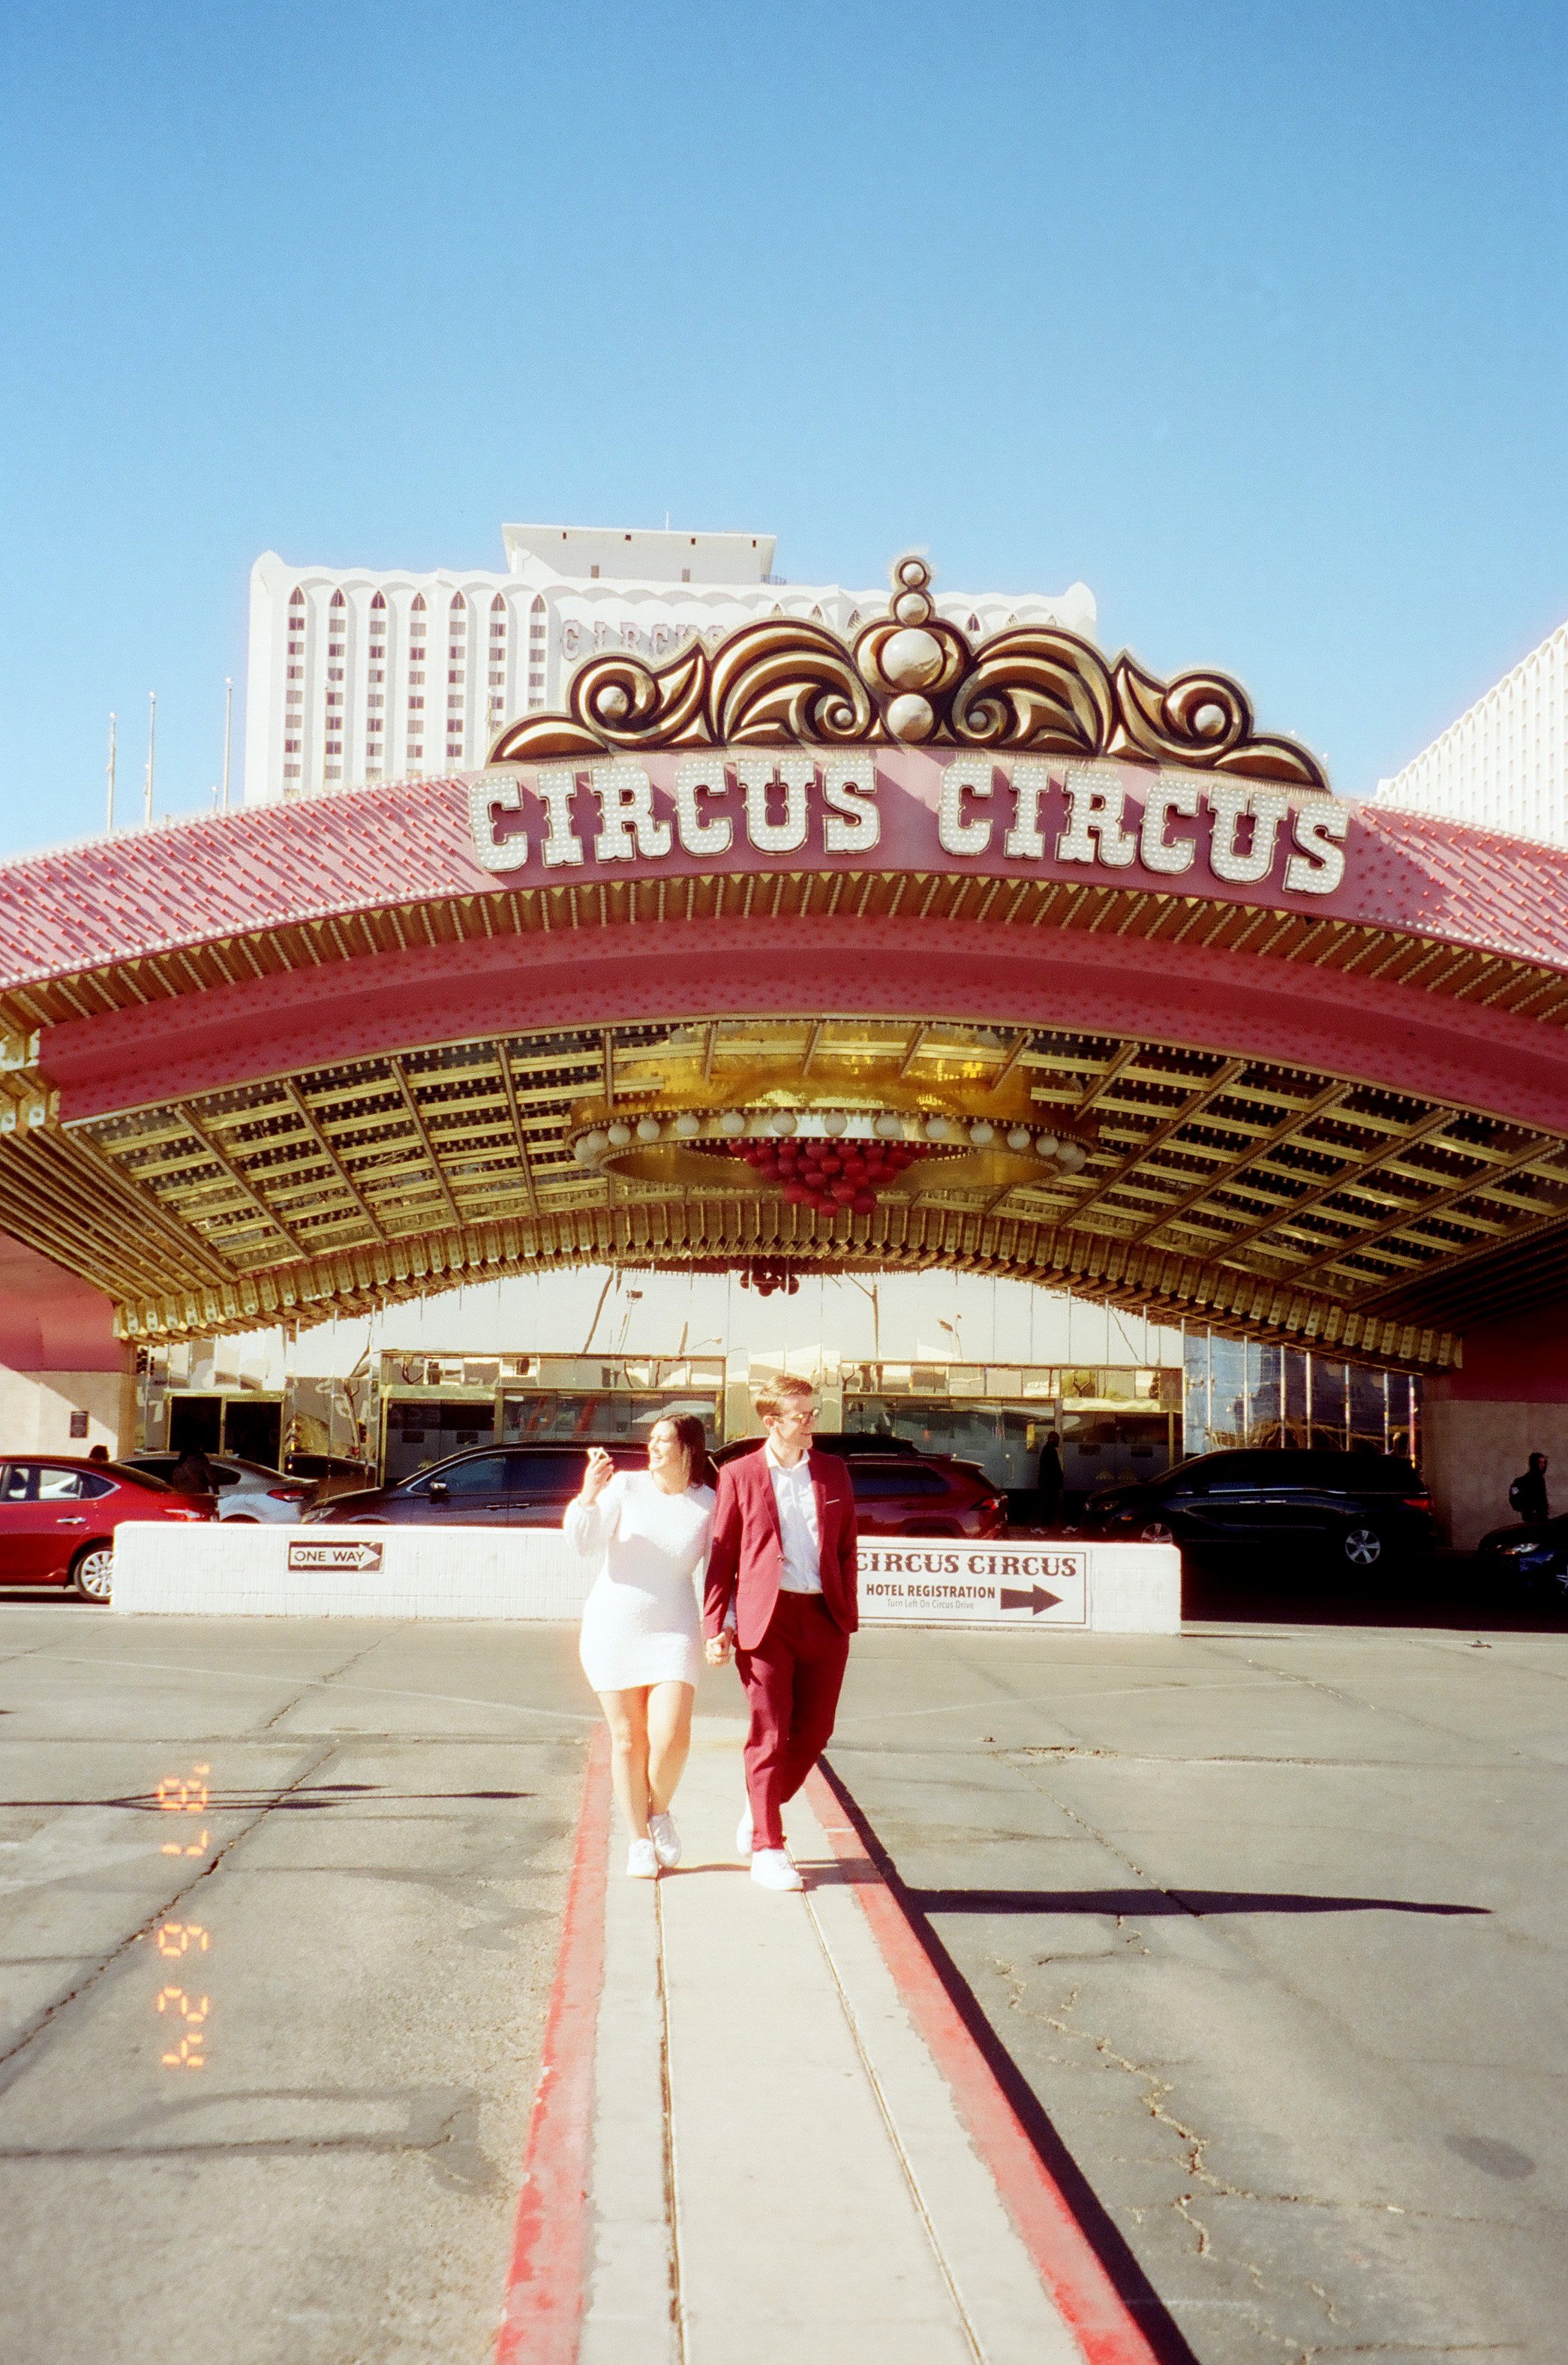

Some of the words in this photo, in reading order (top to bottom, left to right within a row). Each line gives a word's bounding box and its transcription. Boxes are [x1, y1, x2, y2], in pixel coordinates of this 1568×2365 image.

[467, 758, 881, 873] CIRCUS
[938, 759, 1351, 896] CIRCUS
[294, 1551, 326, 1561] ONE
[333, 1551, 365, 1561] WAY
[968, 1555, 1077, 1577] CIRCUS
[866, 1584, 904, 1596] HOTEL
[907, 1585, 995, 1599] REGISTRATION
[888, 1599, 903, 1607] Turn
[905, 1599, 918, 1607] Left
[932, 1600, 954, 1609] Circus
[955, 1600, 975, 1609] Drive
